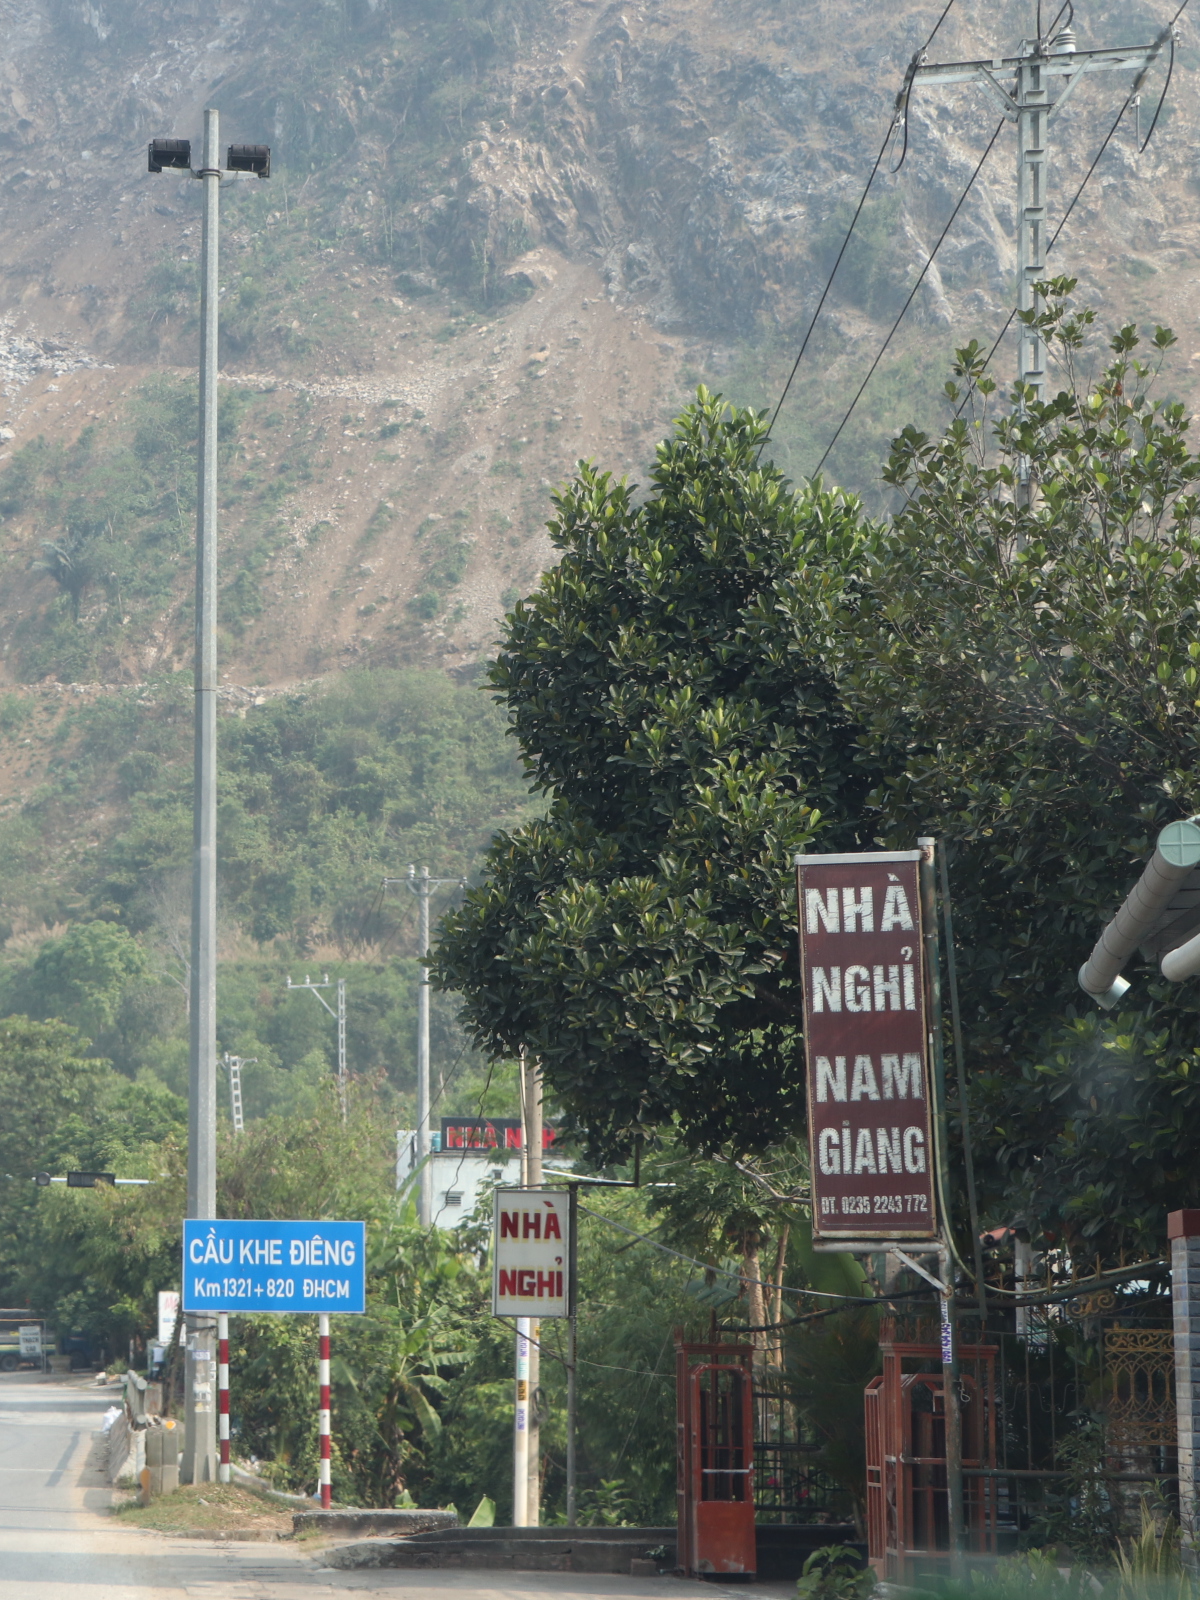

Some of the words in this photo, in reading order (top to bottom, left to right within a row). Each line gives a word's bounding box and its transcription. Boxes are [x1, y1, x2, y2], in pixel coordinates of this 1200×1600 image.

[804, 873, 914, 934] NHÀ
[811, 946, 917, 1014] NGHỈ
[815, 1052, 923, 1103] NAM
[447, 1123, 498, 1148] NHÀ
[500, 1200, 562, 1240] NHÀ
[841, 1196, 870, 1214] 0235
[873, 1195, 902, 1214] 2243
[904, 1194, 928, 1213] 772
[189, 1227, 234, 1264] CẦU
[239, 1239, 283, 1265] KHE
[289, 1234, 356, 1266] ĐIÊNG
[303, 1278, 350, 1298] ĐHCM
[499, 1256, 563, 1298] NGHỈ
